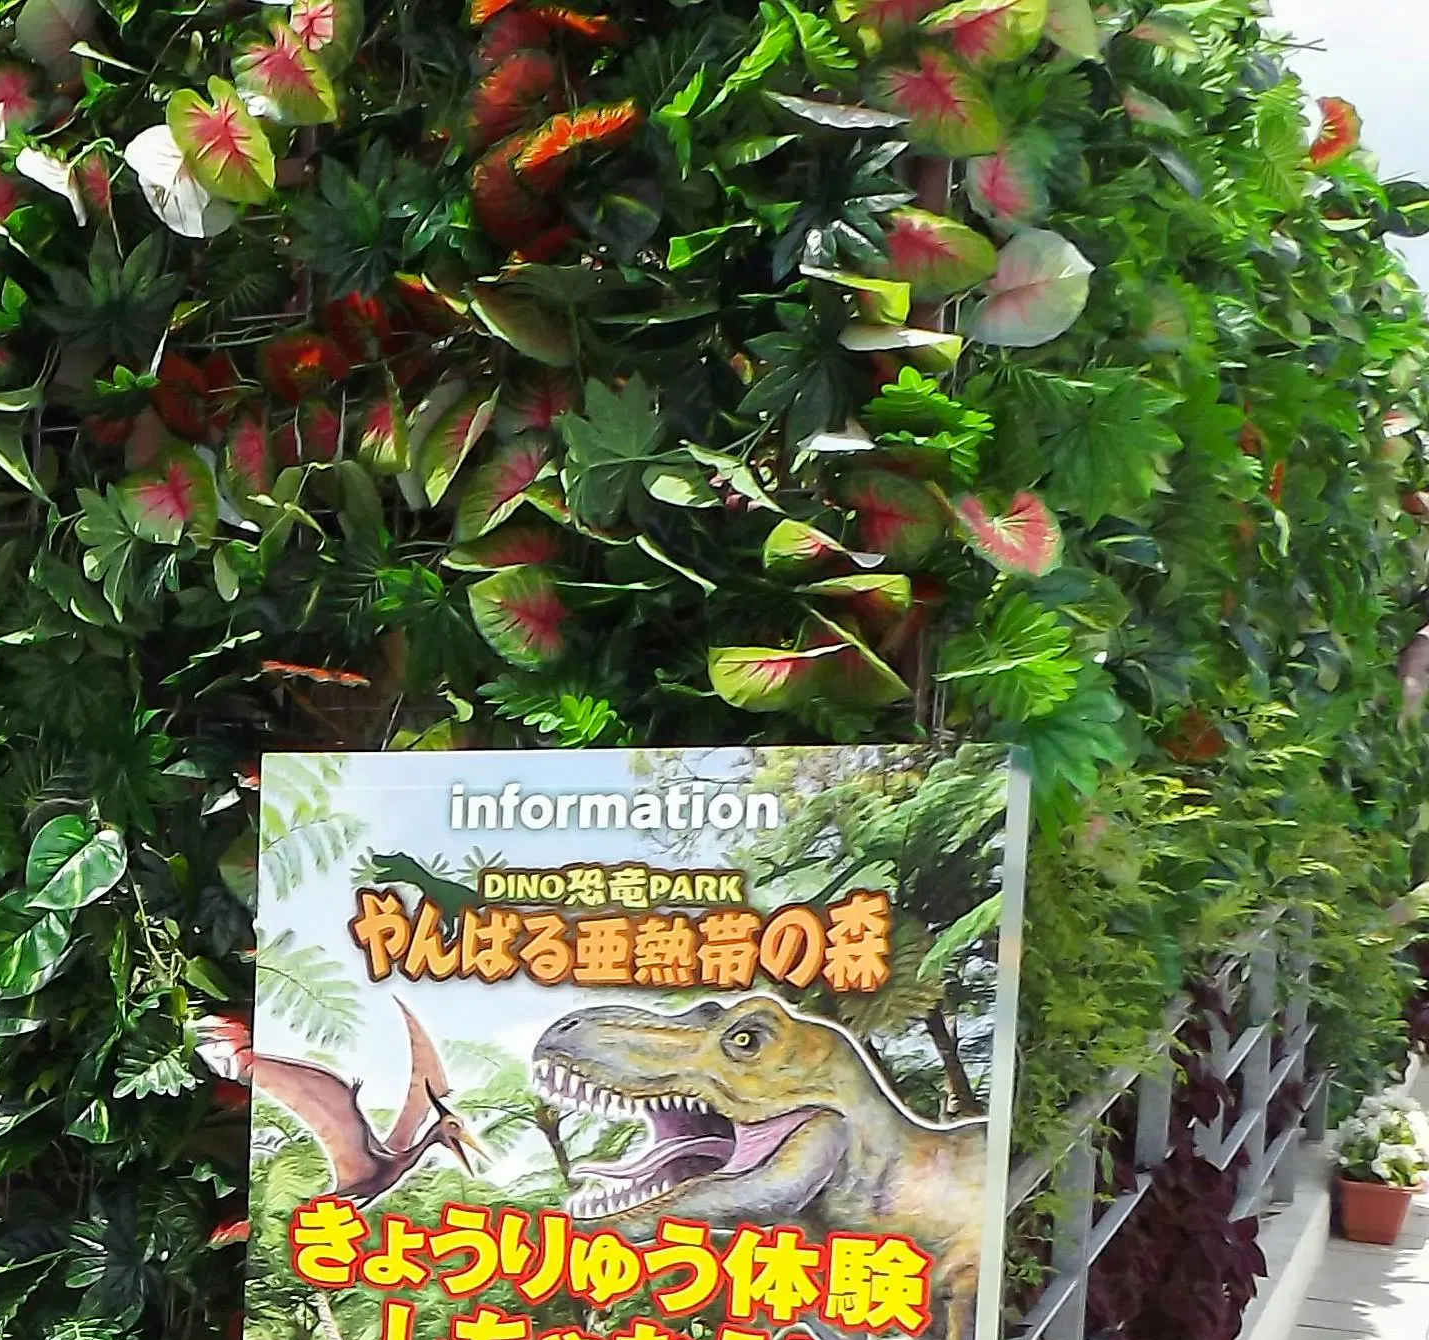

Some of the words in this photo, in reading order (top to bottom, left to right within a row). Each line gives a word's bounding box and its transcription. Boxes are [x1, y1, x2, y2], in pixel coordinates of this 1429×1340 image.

[450, 783, 780, 832] information
[482, 870, 743, 908] DINO恐竜PARK
[354, 893, 891, 991] やんばる亜熱帯の森
[293, 1201, 928, 1329] きょうりゅう体験
